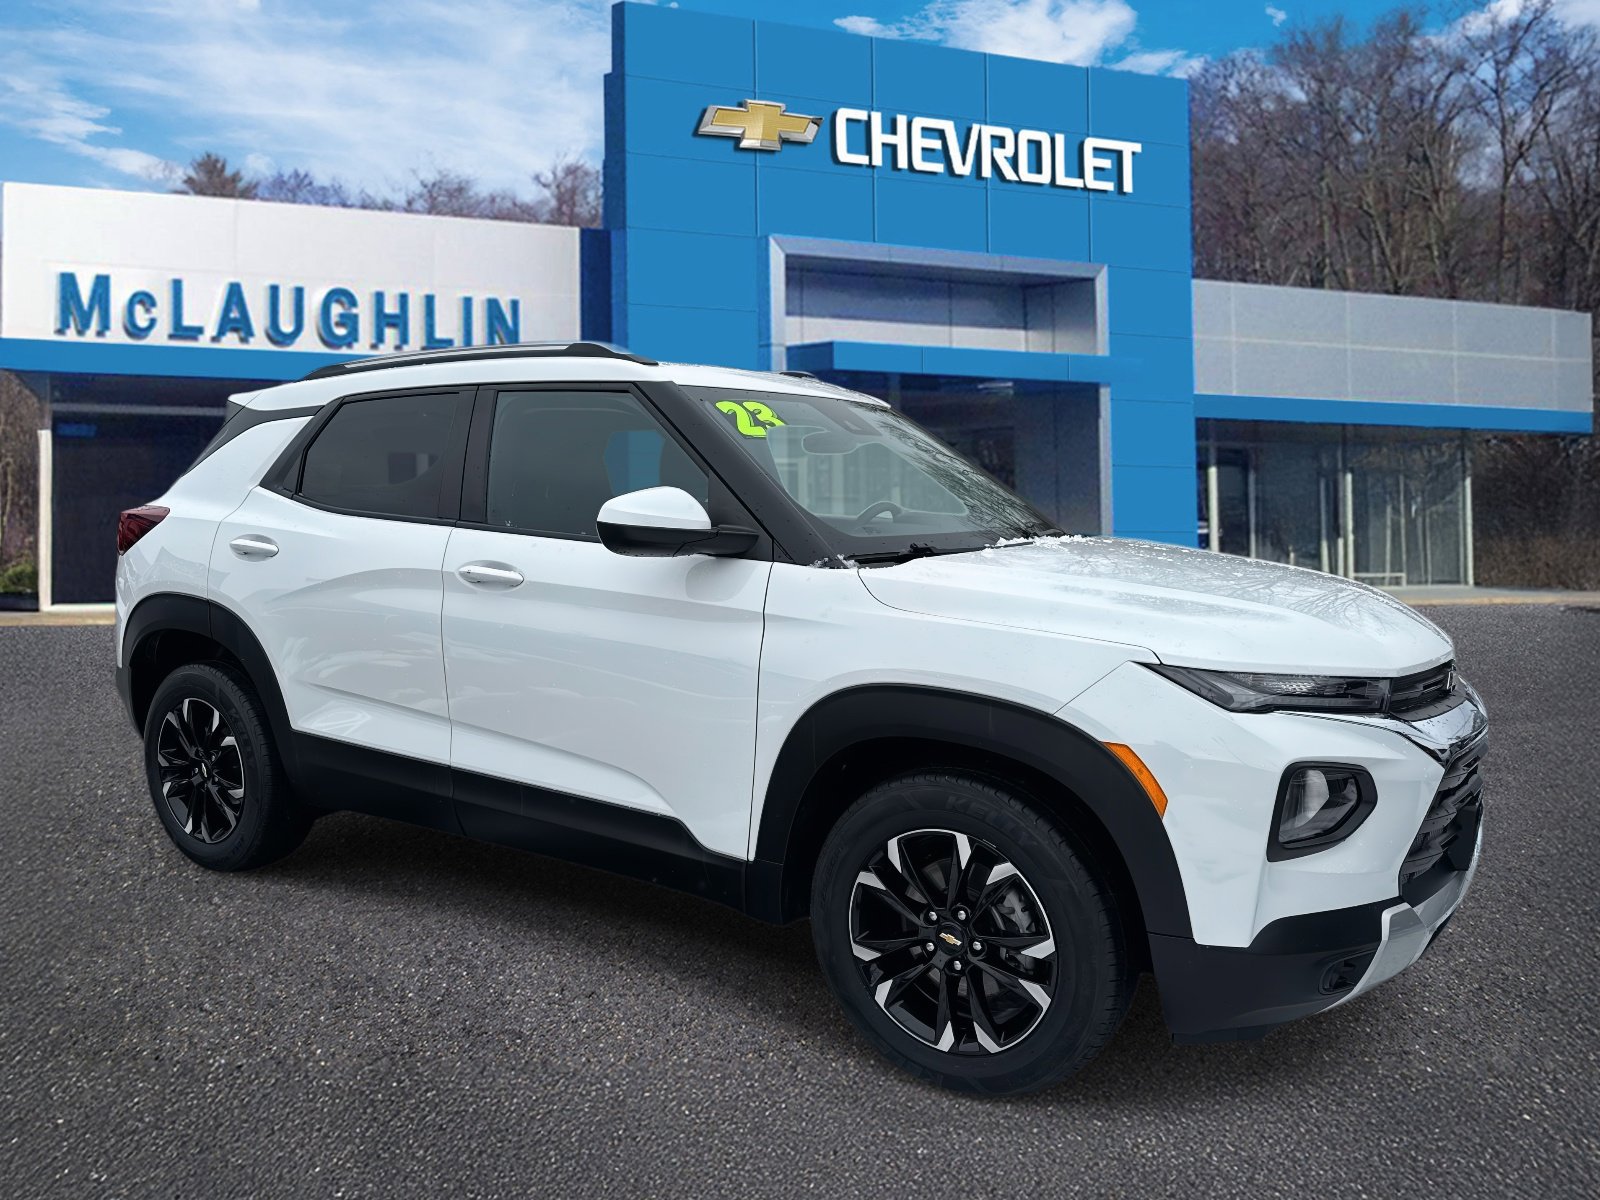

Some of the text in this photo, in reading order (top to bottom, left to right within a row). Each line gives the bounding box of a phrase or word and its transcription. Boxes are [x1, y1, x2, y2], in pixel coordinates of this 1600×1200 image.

[834, 107, 1142, 193] CHEVROLET
[55, 271, 521, 350] McLAUGHLIN
[715, 400, 786, 438] 23
